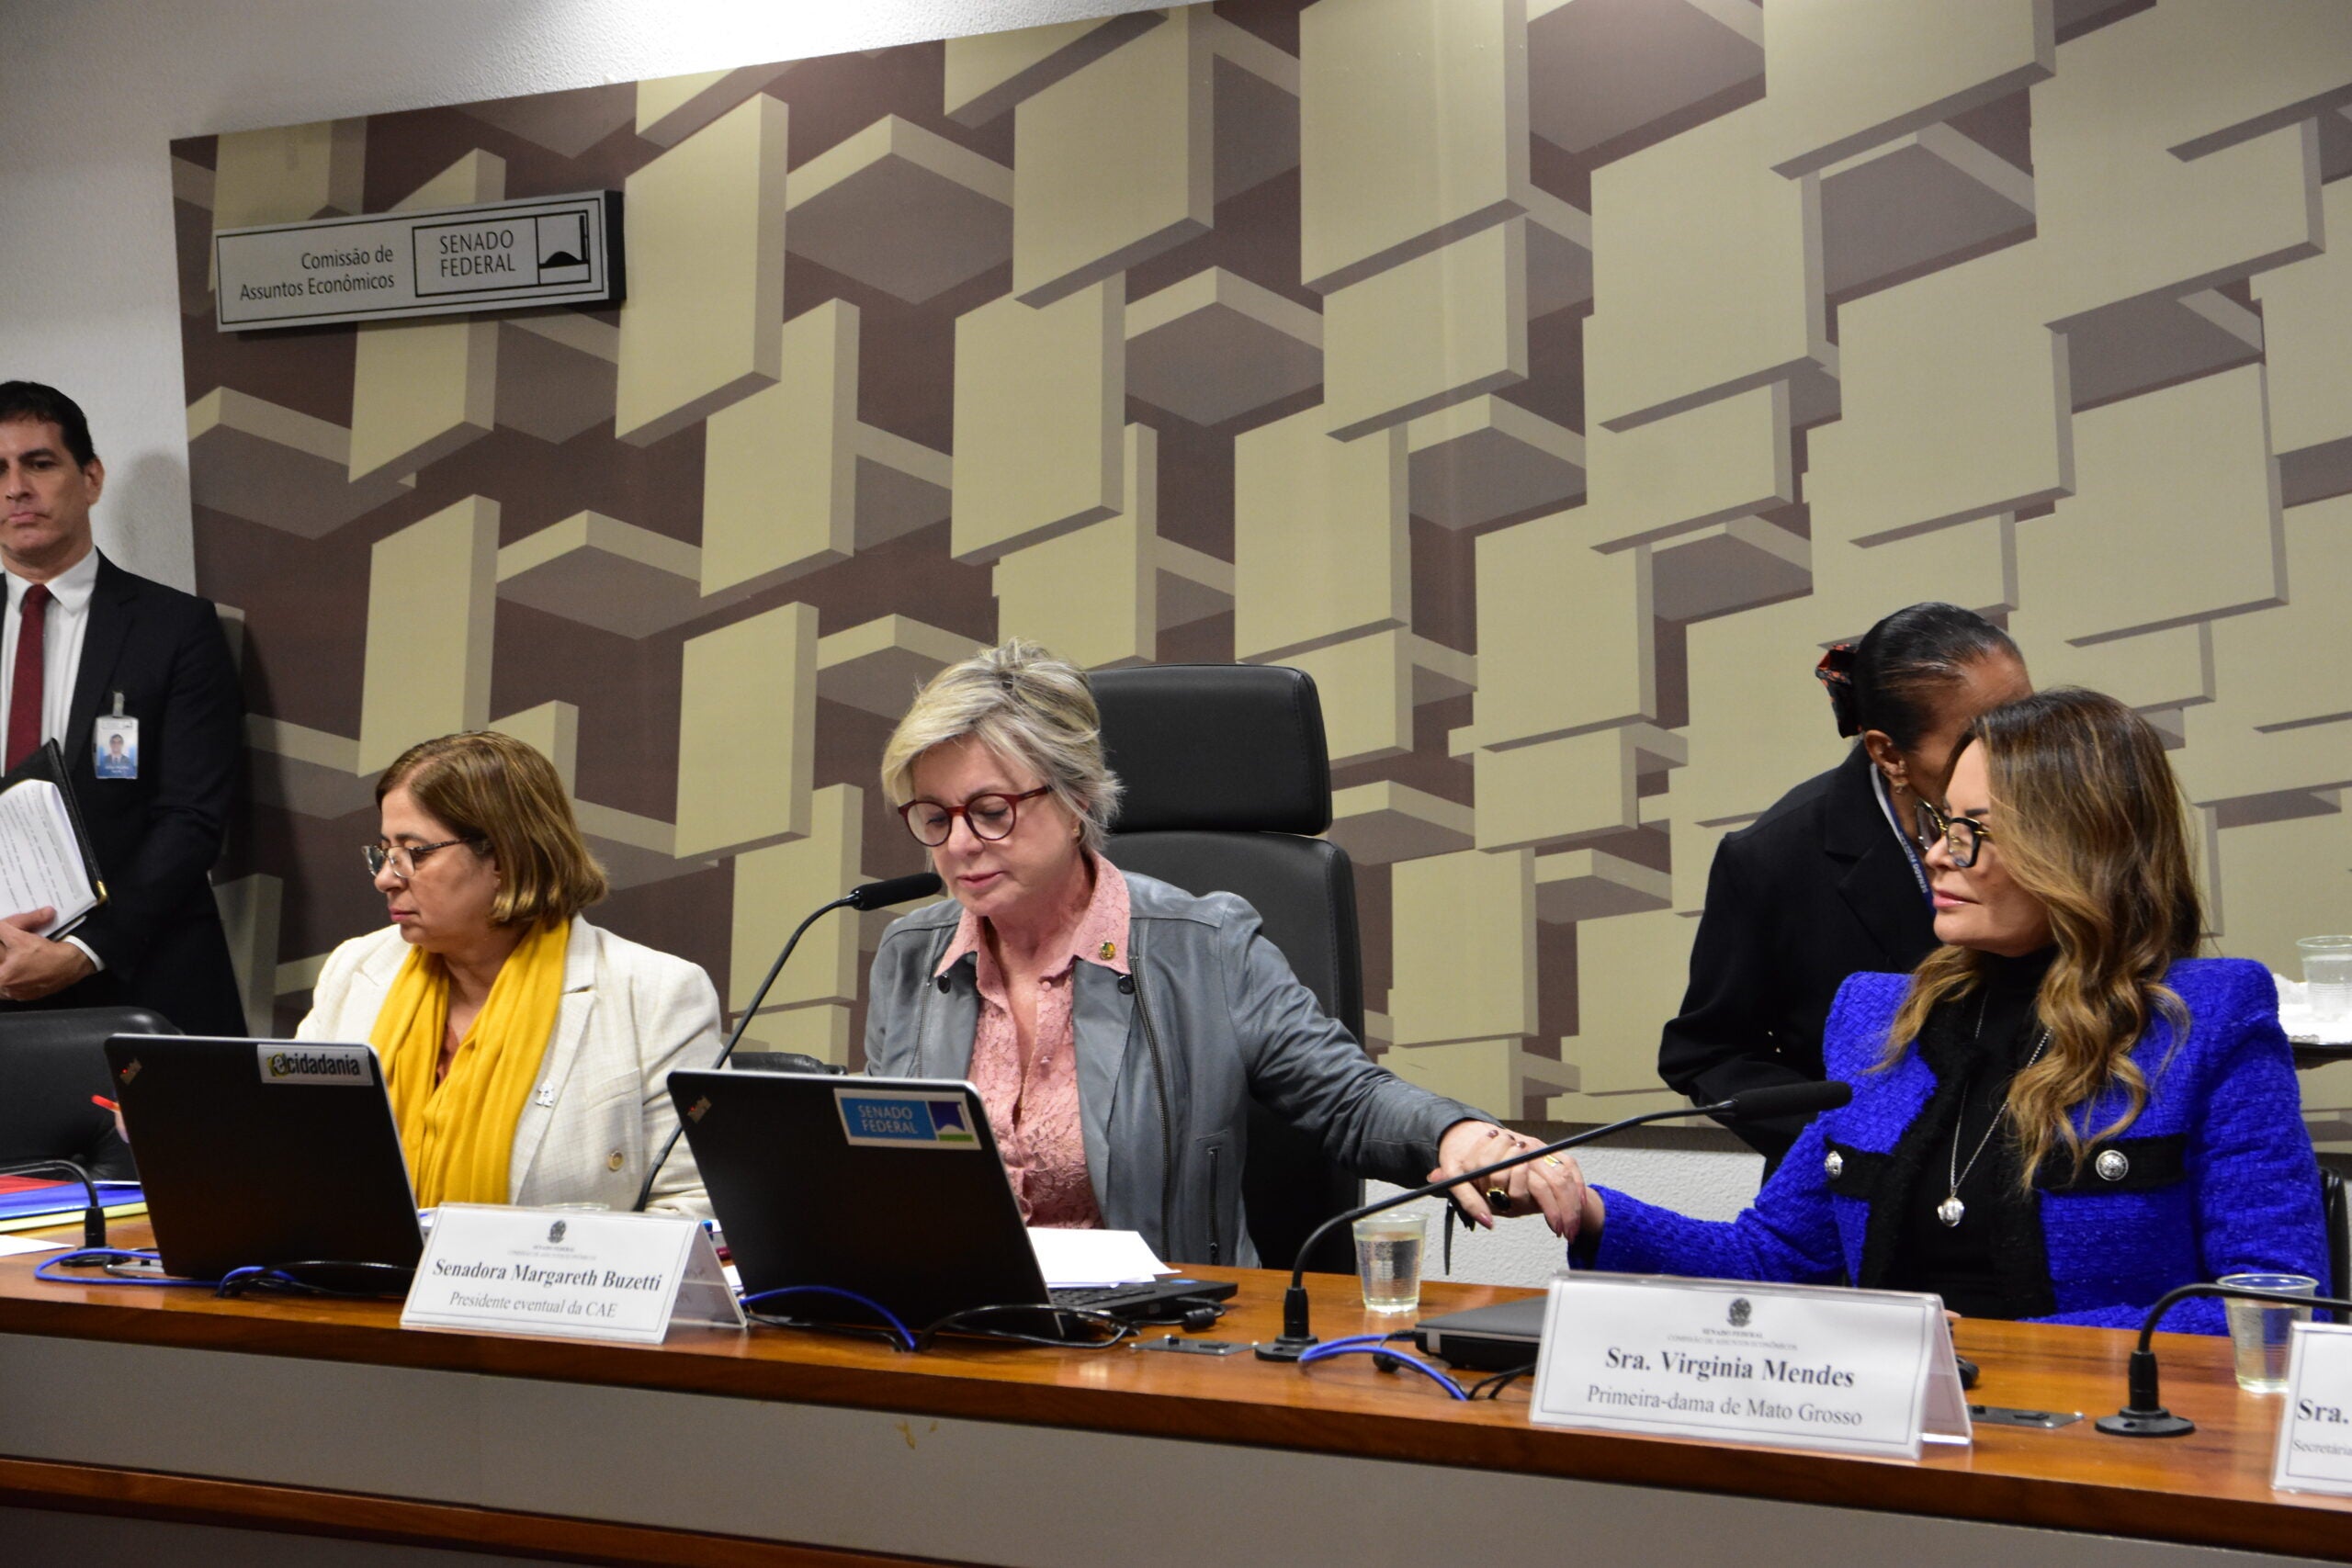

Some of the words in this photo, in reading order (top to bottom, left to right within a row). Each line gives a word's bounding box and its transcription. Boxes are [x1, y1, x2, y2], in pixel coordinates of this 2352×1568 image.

[439, 229, 514, 254] SENADO
[301, 247, 370, 270] Comissão
[375, 244, 394, 264] de
[440, 253, 516, 277] FEDERAL
[239, 282, 305, 301] Assuntos
[308, 273, 395, 296] Econômicos
[1912, 863, 1928, 894] SENADO
[857, 1104, 913, 1120] SENADO
[862, 1119, 919, 1134] FEDERAL
[433, 1258, 507, 1280] Senadora
[511, 1264, 598, 1289] Margareth
[603, 1270, 662, 1292] Buzetti
[449, 1291, 511, 1310] Presidente
[513, 1298, 566, 1314] eventual
[567, 1299, 582, 1315] da
[585, 1301, 618, 1318] CAE
[1605, 1347, 1651, 1371] Sra.
[1661, 1350, 1753, 1382] Virginia
[1762, 1359, 1855, 1388] Mendes
[1588, 1384, 1714, 1414] Primeira-dama
[1720, 1397, 1741, 1416] de
[1747, 1398, 1793, 1420] Mato
[1798, 1403, 1862, 1426] Grosso
[2297, 1398, 2348, 1424] Sra.
